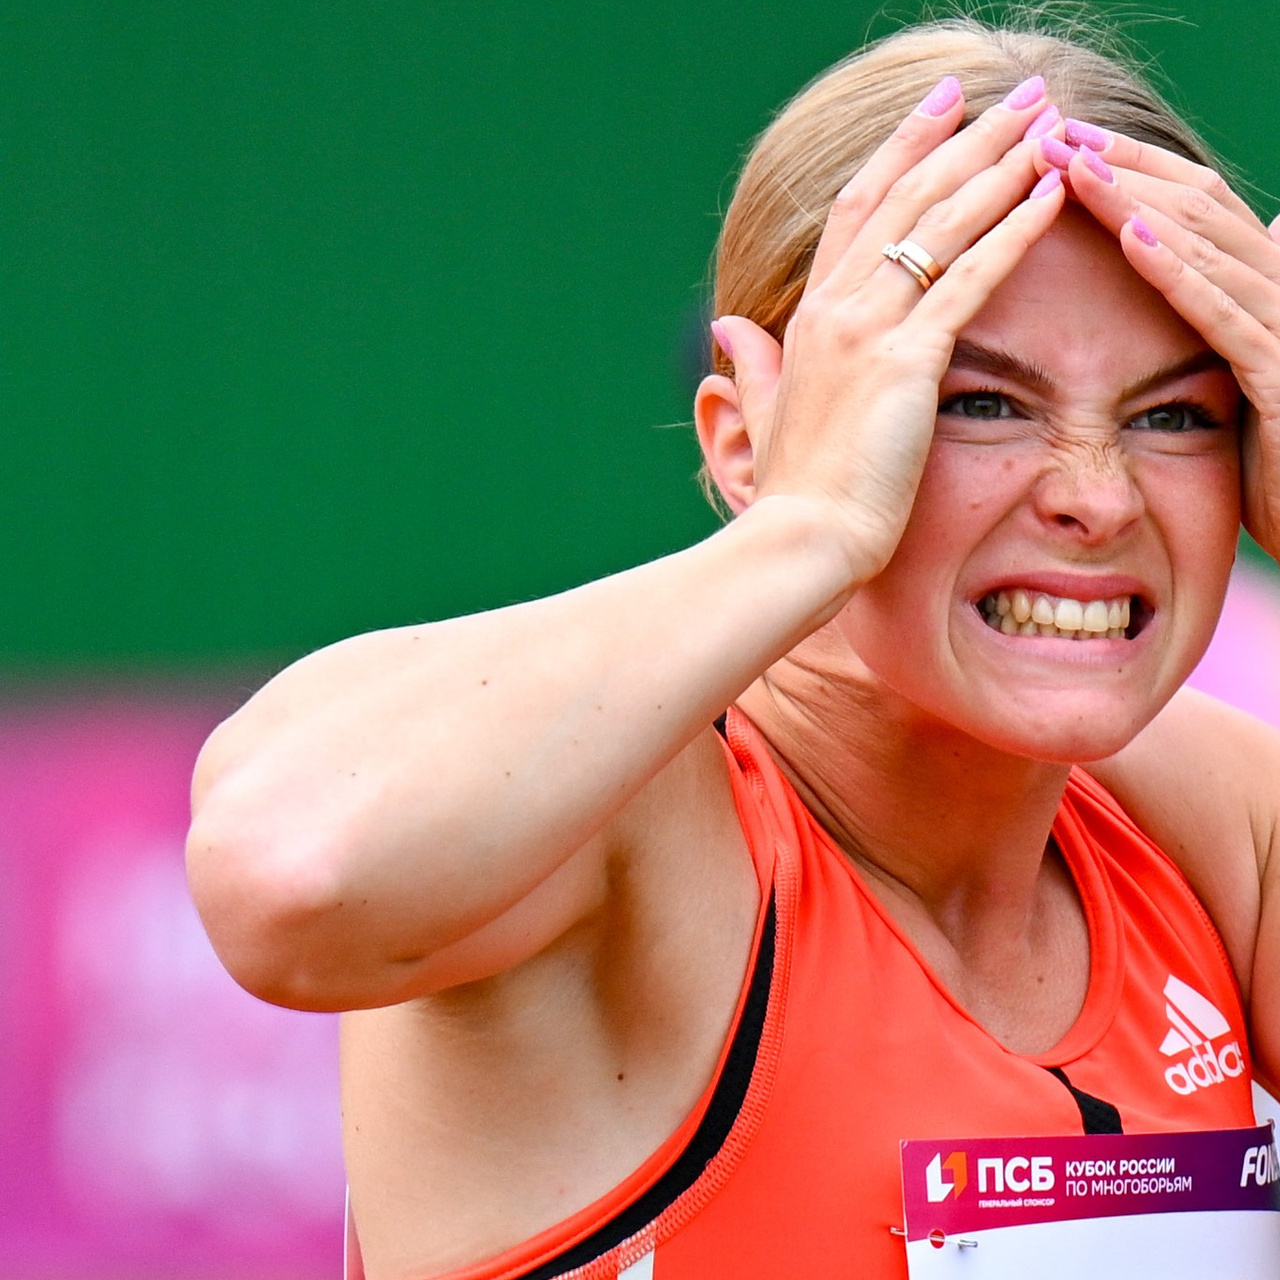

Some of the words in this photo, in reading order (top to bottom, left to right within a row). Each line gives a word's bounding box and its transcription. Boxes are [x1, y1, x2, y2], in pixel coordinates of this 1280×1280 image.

[978, 1156, 1055, 1193] ПСБ
[1066, 1160, 1116, 1177] КУБОК
[1120, 1158, 1175, 1175] РОССИИ
[1066, 1180, 1087, 1196] ПО
[1091, 1176, 1192, 1196] МНОГОБОРЬЯМ
